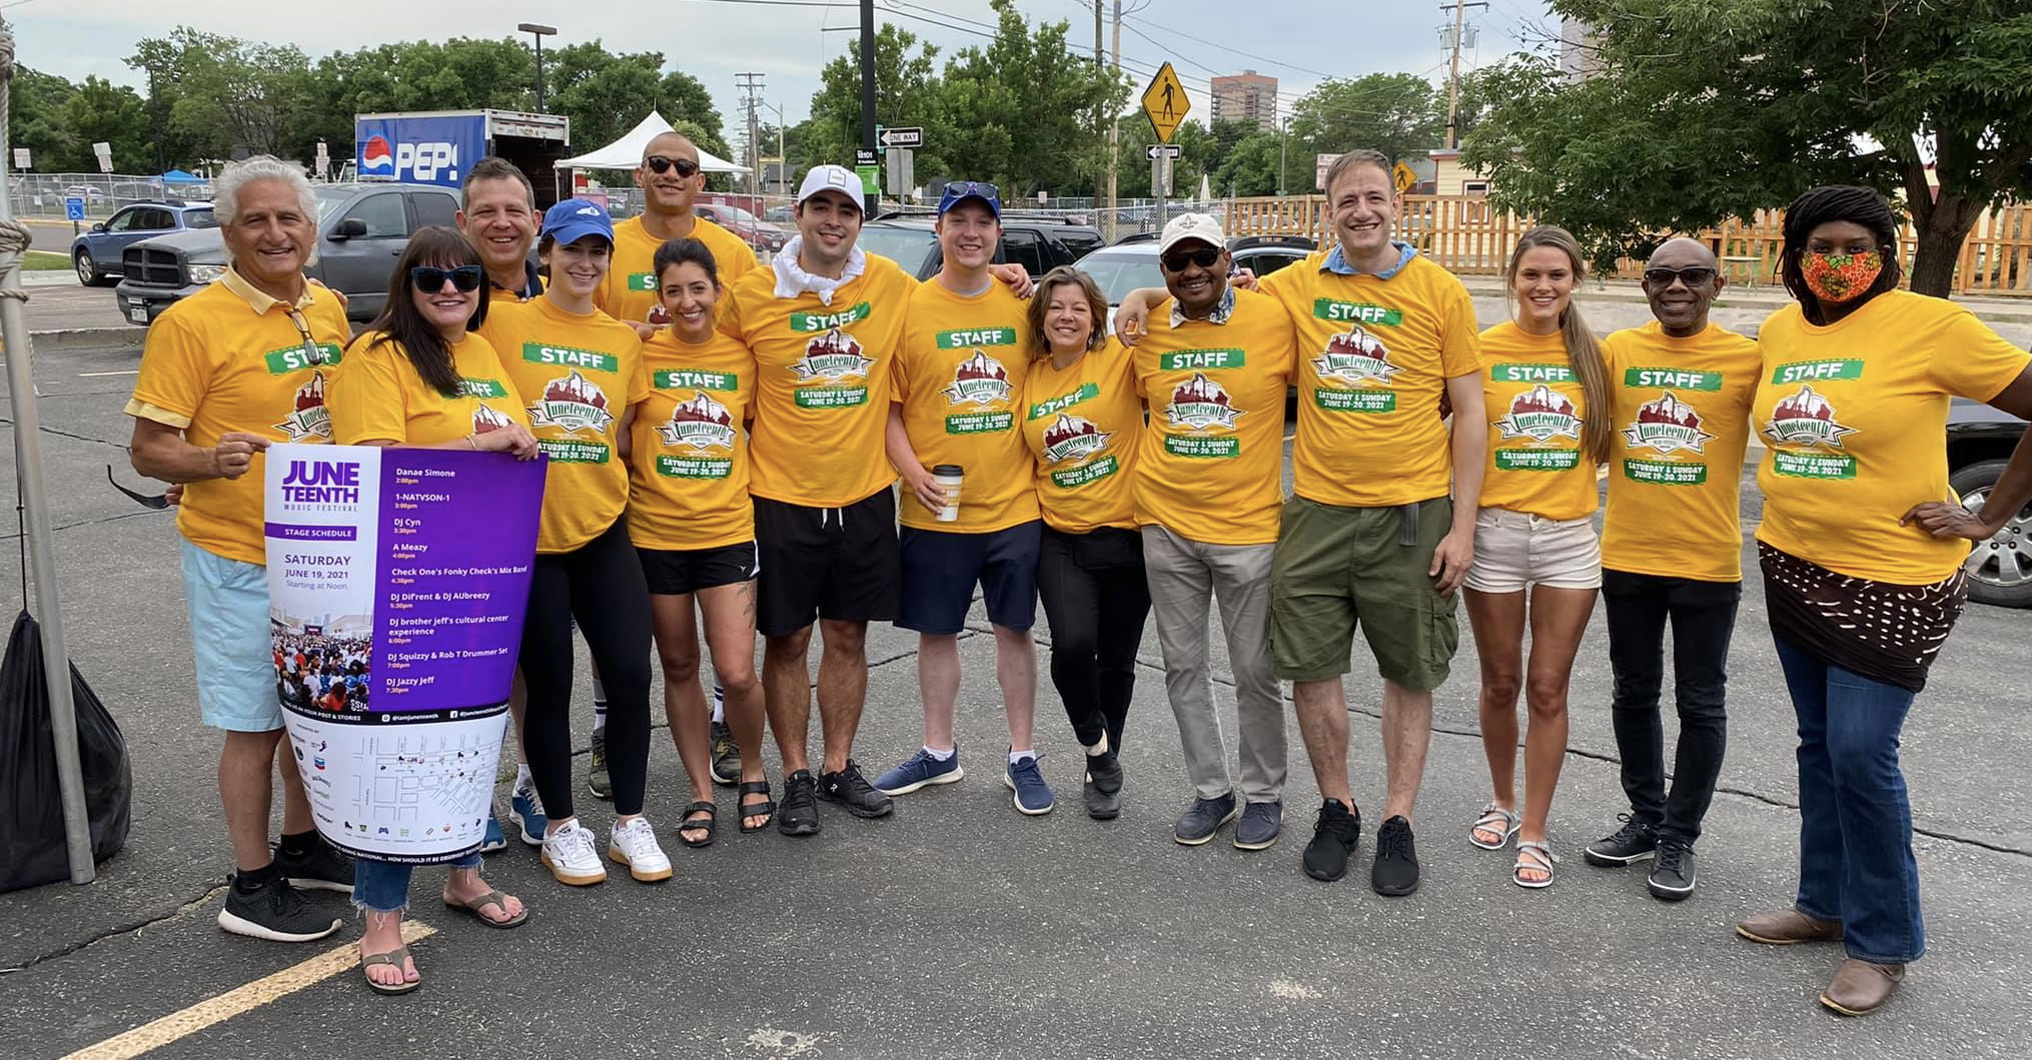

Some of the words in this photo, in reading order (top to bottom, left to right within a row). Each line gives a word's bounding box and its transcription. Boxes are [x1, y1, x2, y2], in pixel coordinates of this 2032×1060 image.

[1328, 303, 1386, 322] STAFF
[806, 310, 858, 330] STAFF
[951, 330, 1002, 346] STAFF
[283, 348, 330, 368] STFF
[540, 348, 603, 367] STAFF
[1173, 352, 1228, 368] STAFF
[1508, 367, 1570, 380] STAFF
[1783, 363, 1844, 383] STAFF
[669, 373, 724, 388] STAFF
[1639, 371, 1703, 388] STAFF
[800, 390, 835, 398] SATURDAY
[1318, 391, 1353, 401] SATURDAY
[847, 396, 860, 404] 2021
[1037, 390, 1083, 417] STAFF
[951, 416, 984, 425] SATURDAY
[537, 442, 570, 451] ATURDAY
[578, 445, 606, 454] SUNDAY
[1168, 438, 1200, 448] SATURDAY
[663, 459, 699, 468] SATURDAY
[1777, 454, 1808, 464] SATURDAY
[1096, 467, 1109, 476] 2021
[1628, 462, 1665, 473] SATURDAY
[1780, 463, 1797, 471] JUNE
[283, 461, 360, 486] JUNE
[396, 468, 423, 476] Danae
[424, 469, 456, 477] Simone
[1056, 470, 1083, 480] SATURDAY
[1634, 471, 1652, 479] JUNE
[282, 486, 359, 503] TEENTH
[394, 519, 403, 527] DJ
[405, 519, 421, 528] Cyn
[312, 529, 352, 537] SCHEDULE
[401, 544, 428, 552] Meazy
[285, 554, 351, 565] SATURDAY
[285, 569, 309, 578] JUNE
[327, 571, 348, 579] 2021
[392, 568, 417, 576] Check
[419, 568, 442, 576] One's
[286, 580, 315, 590] Starting
[391, 593, 400, 602] DJ
[443, 593, 452, 601] DJ
[390, 619, 399, 627] DJ
[400, 618, 432, 626] brother
[455, 616, 485, 624] cultural
[389, 628, 435, 637] experience
[388, 654, 397, 662] DJ
[399, 653, 429, 662] Squizzy
[439, 651, 454, 659] Rob
[463, 649, 498, 657] Drummer
[386, 679, 396, 687] DJ
[397, 678, 418, 686] Jazzy
[420, 676, 435, 685] Jeff
